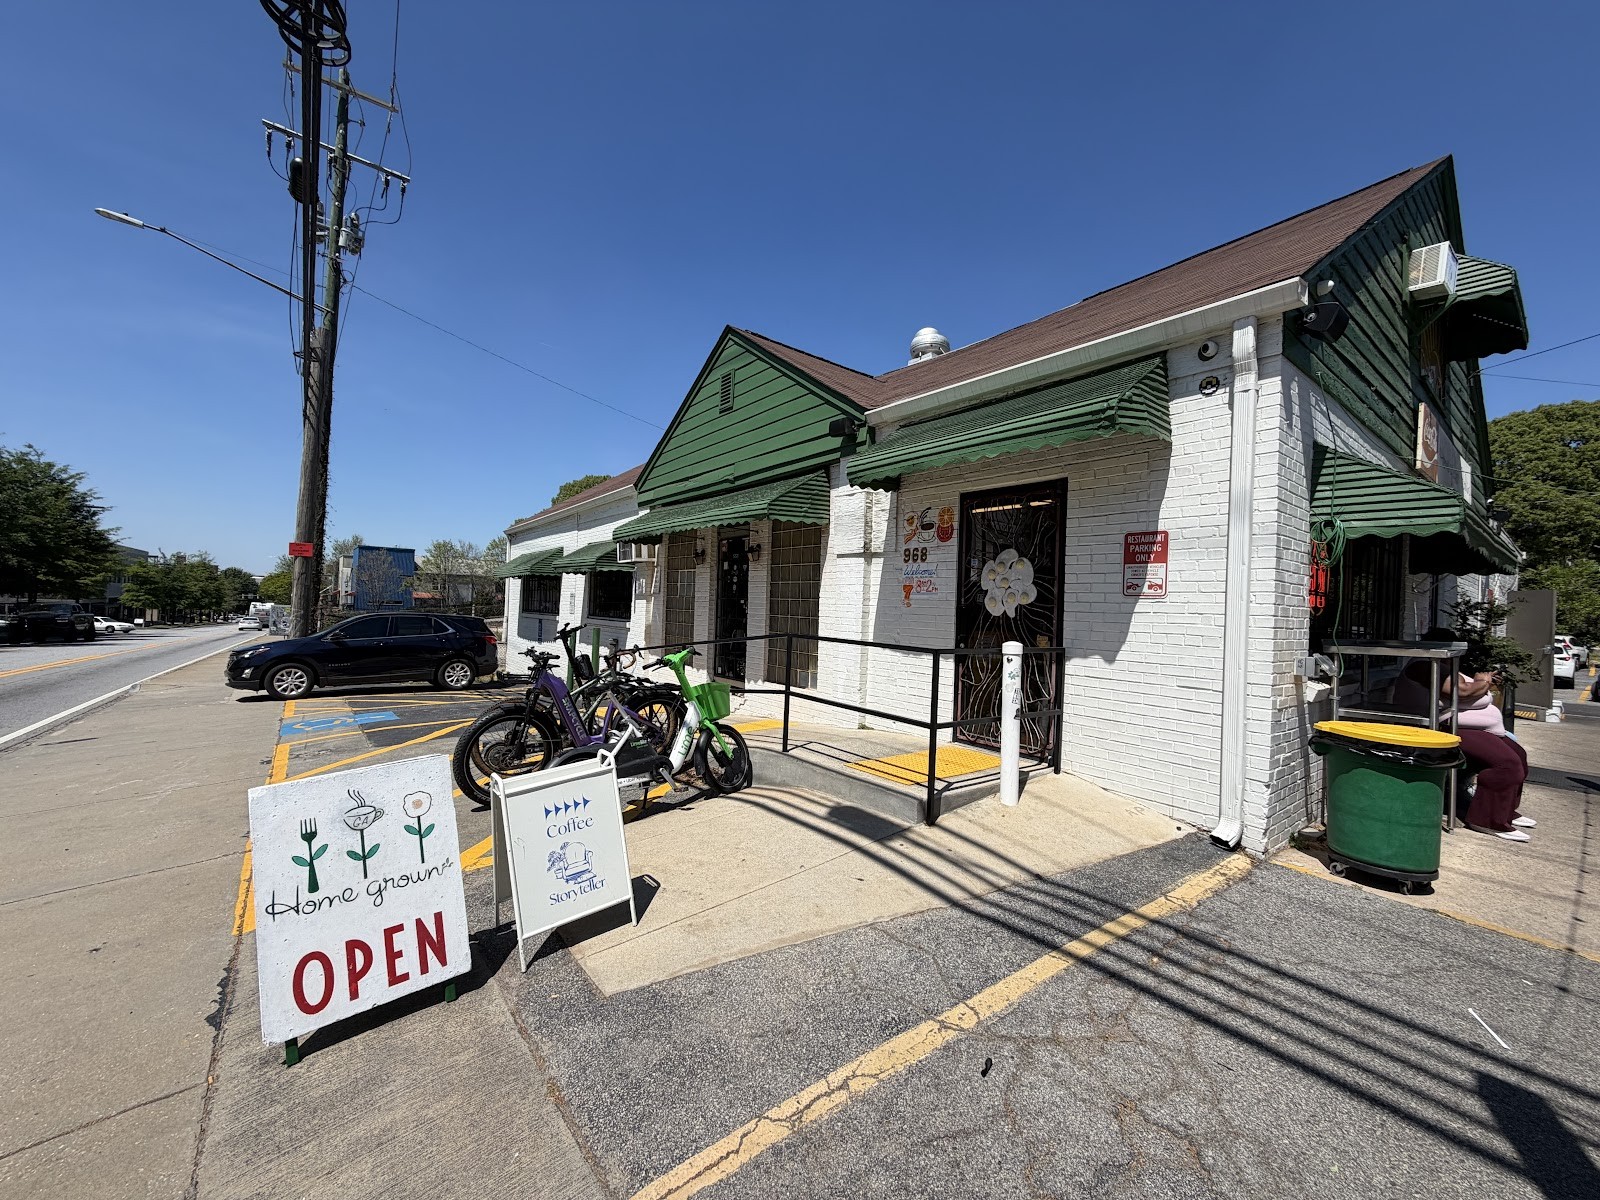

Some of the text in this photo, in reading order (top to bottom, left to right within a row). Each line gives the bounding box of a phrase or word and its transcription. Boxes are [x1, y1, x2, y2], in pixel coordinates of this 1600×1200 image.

[1128, 534, 1165, 543] RESTAURANT
[1130, 544, 1162, 552] PARKING
[903, 547, 928, 563] 968
[1135, 554, 1155, 562] ONLY
[678, 726, 693, 756] Lime
[353, 816, 369, 828] GA
[546, 816, 594, 838] Coffee
[265, 858, 453, 922] Home grown
[549, 878, 606, 906] Storyteller
[292, 910, 448, 1015] OPEN
